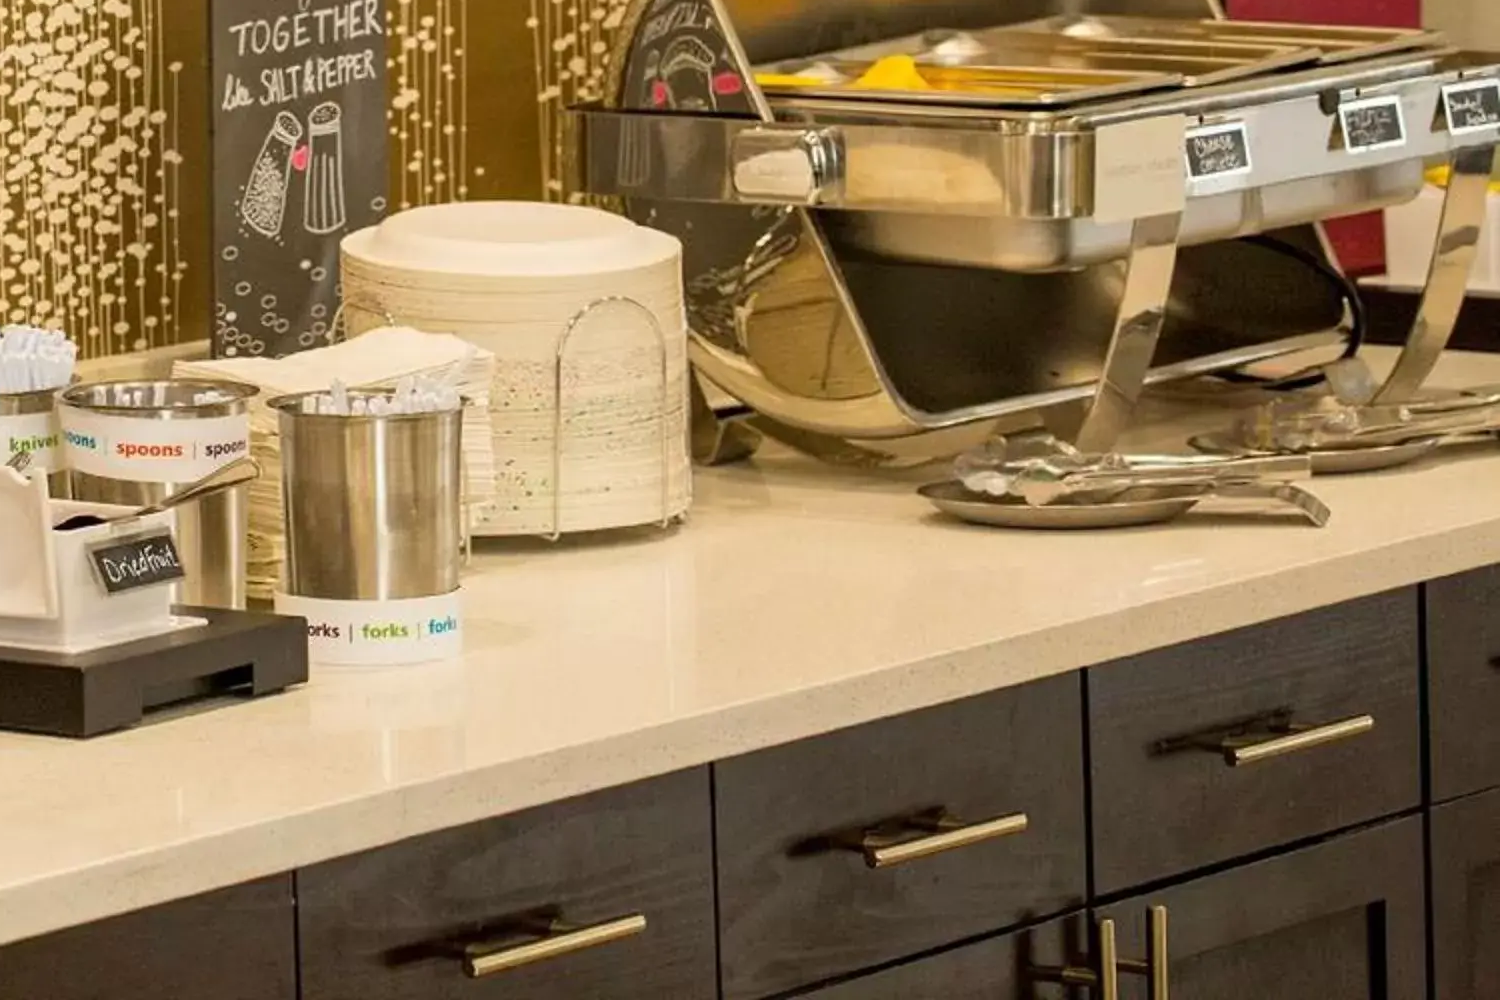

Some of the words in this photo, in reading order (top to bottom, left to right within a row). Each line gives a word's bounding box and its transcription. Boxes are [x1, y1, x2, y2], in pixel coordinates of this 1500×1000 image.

[260, 65, 301, 106] SALT
[317, 49, 376, 93] PEPPER
[115, 440, 183, 459] spoons
[307, 623, 341, 639] orks
[361, 622, 409, 640] forks
